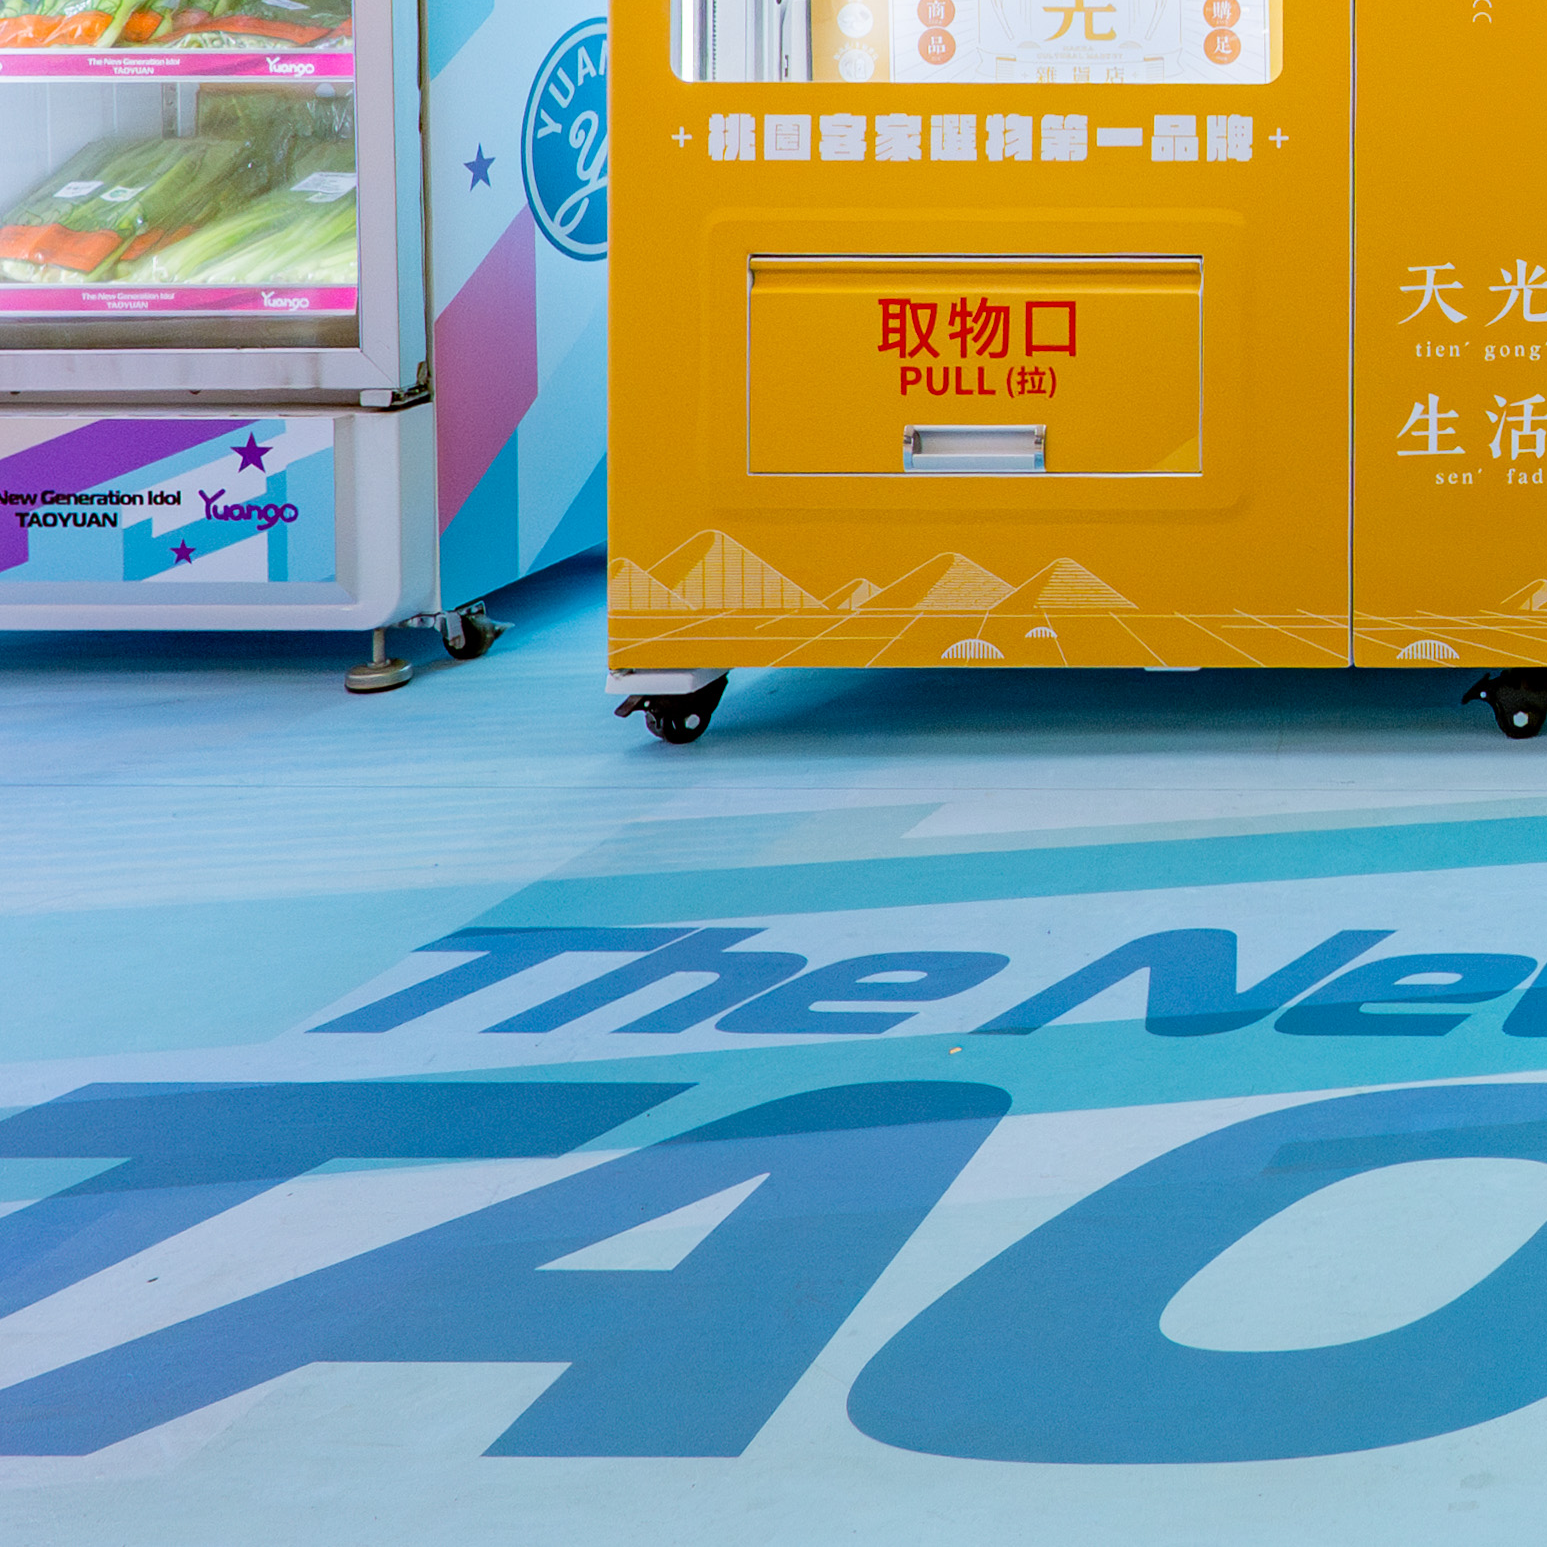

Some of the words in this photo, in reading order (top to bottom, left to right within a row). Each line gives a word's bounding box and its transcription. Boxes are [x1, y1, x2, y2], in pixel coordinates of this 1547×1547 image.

[266, 56, 315, 78] Yuango
[708, 114, 1254, 162] 桃園客家選物第一品牌
[261, 290, 310, 312] Yuango
[877, 297, 1078, 359] 取物口
[900, 366, 996, 396] PULL
[1005, 366, 1058, 398] (拉)
[1506, 467, 1544, 485] fad
[41, 490, 141, 507] Generation
[147, 489, 181, 506] Idol
[199, 490, 298, 530] Yuango
[15, 511, 118, 529] TAOYUAN
[304, 924, 1012, 1035] The
